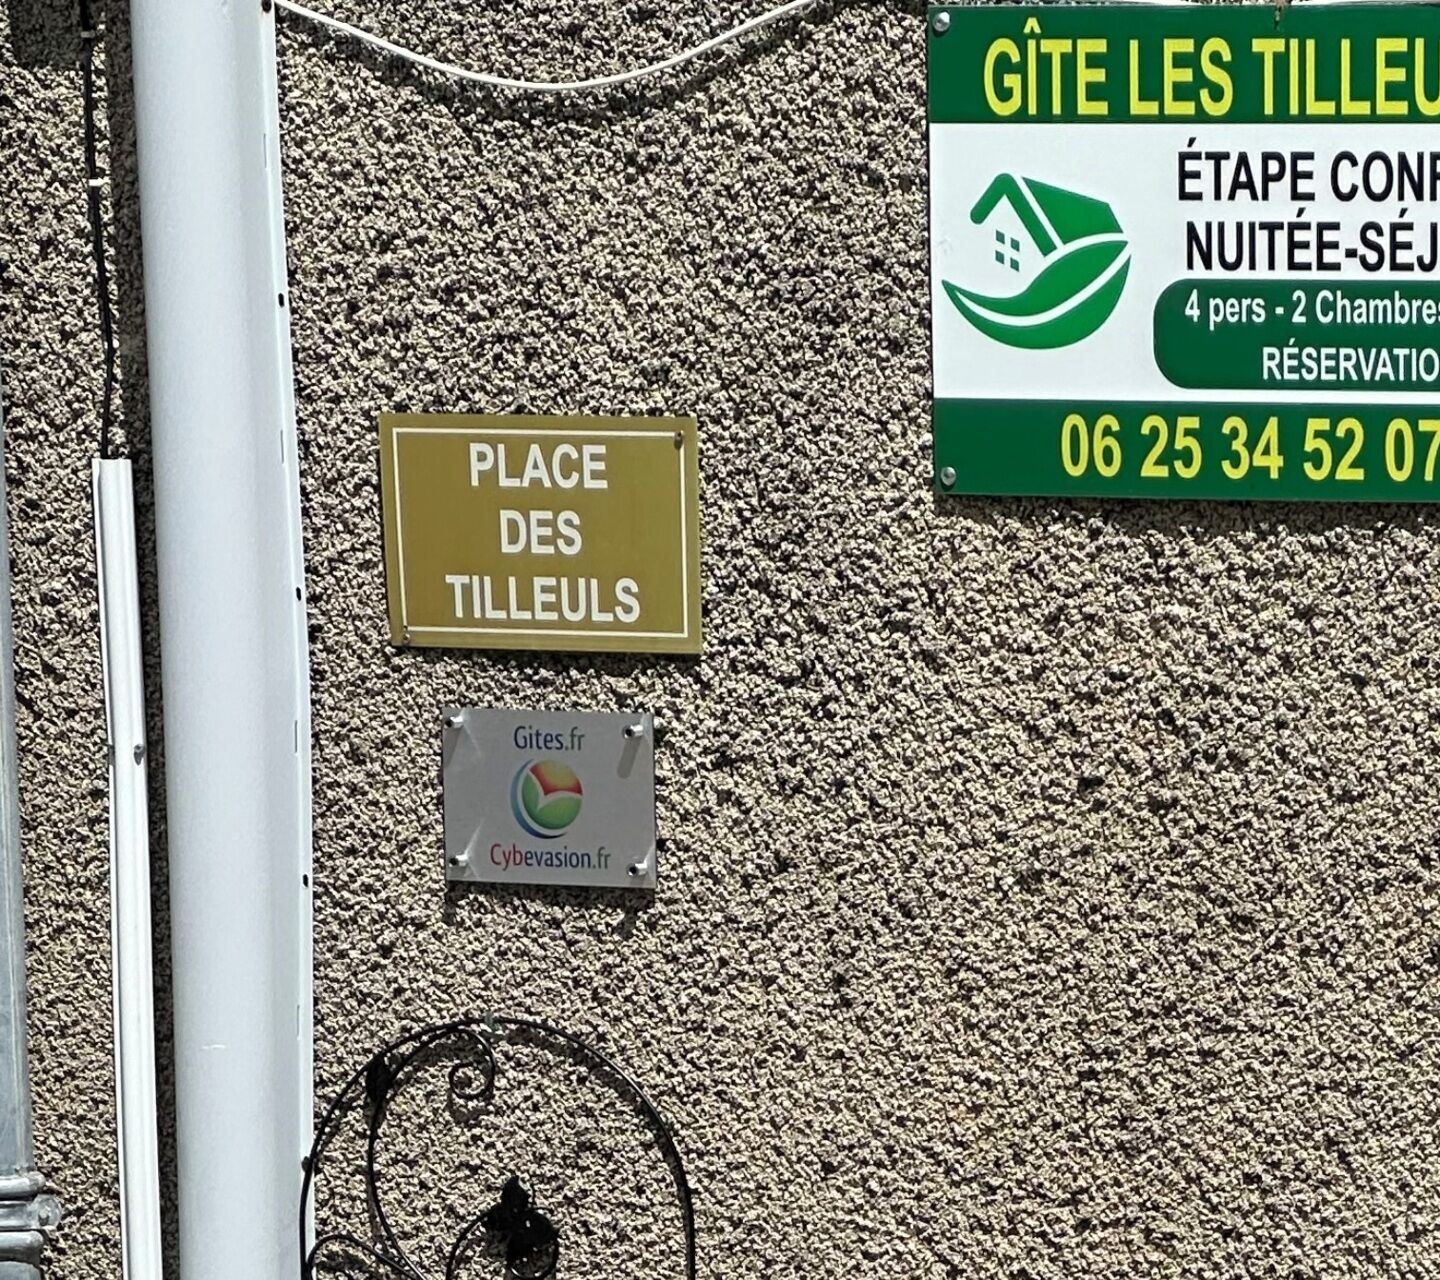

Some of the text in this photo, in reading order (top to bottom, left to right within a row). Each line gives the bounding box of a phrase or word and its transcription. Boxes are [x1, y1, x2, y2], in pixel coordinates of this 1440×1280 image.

[983, 18, 1108, 117] GÎTE
[1128, 38, 1234, 117] LES
[1177, 138, 1317, 202] ÉTAPE
[1184, 290, 1201, 323] 4
[1209, 294, 1266, 330] pers
[1291, 291, 1307, 323] 2
[469, 442, 609, 489] PLACE
[1061, 413, 1121, 477] 06
[1140, 415, 1202, 478] 25
[1221, 416, 1284, 478] 34
[1303, 417, 1364, 480] 52
[499, 509, 583, 556] DES
[445, 574, 641, 624] TILLEULS
[513, 725, 585, 751] Gites.fr
[490, 843, 612, 871] Cybevasion.fr
